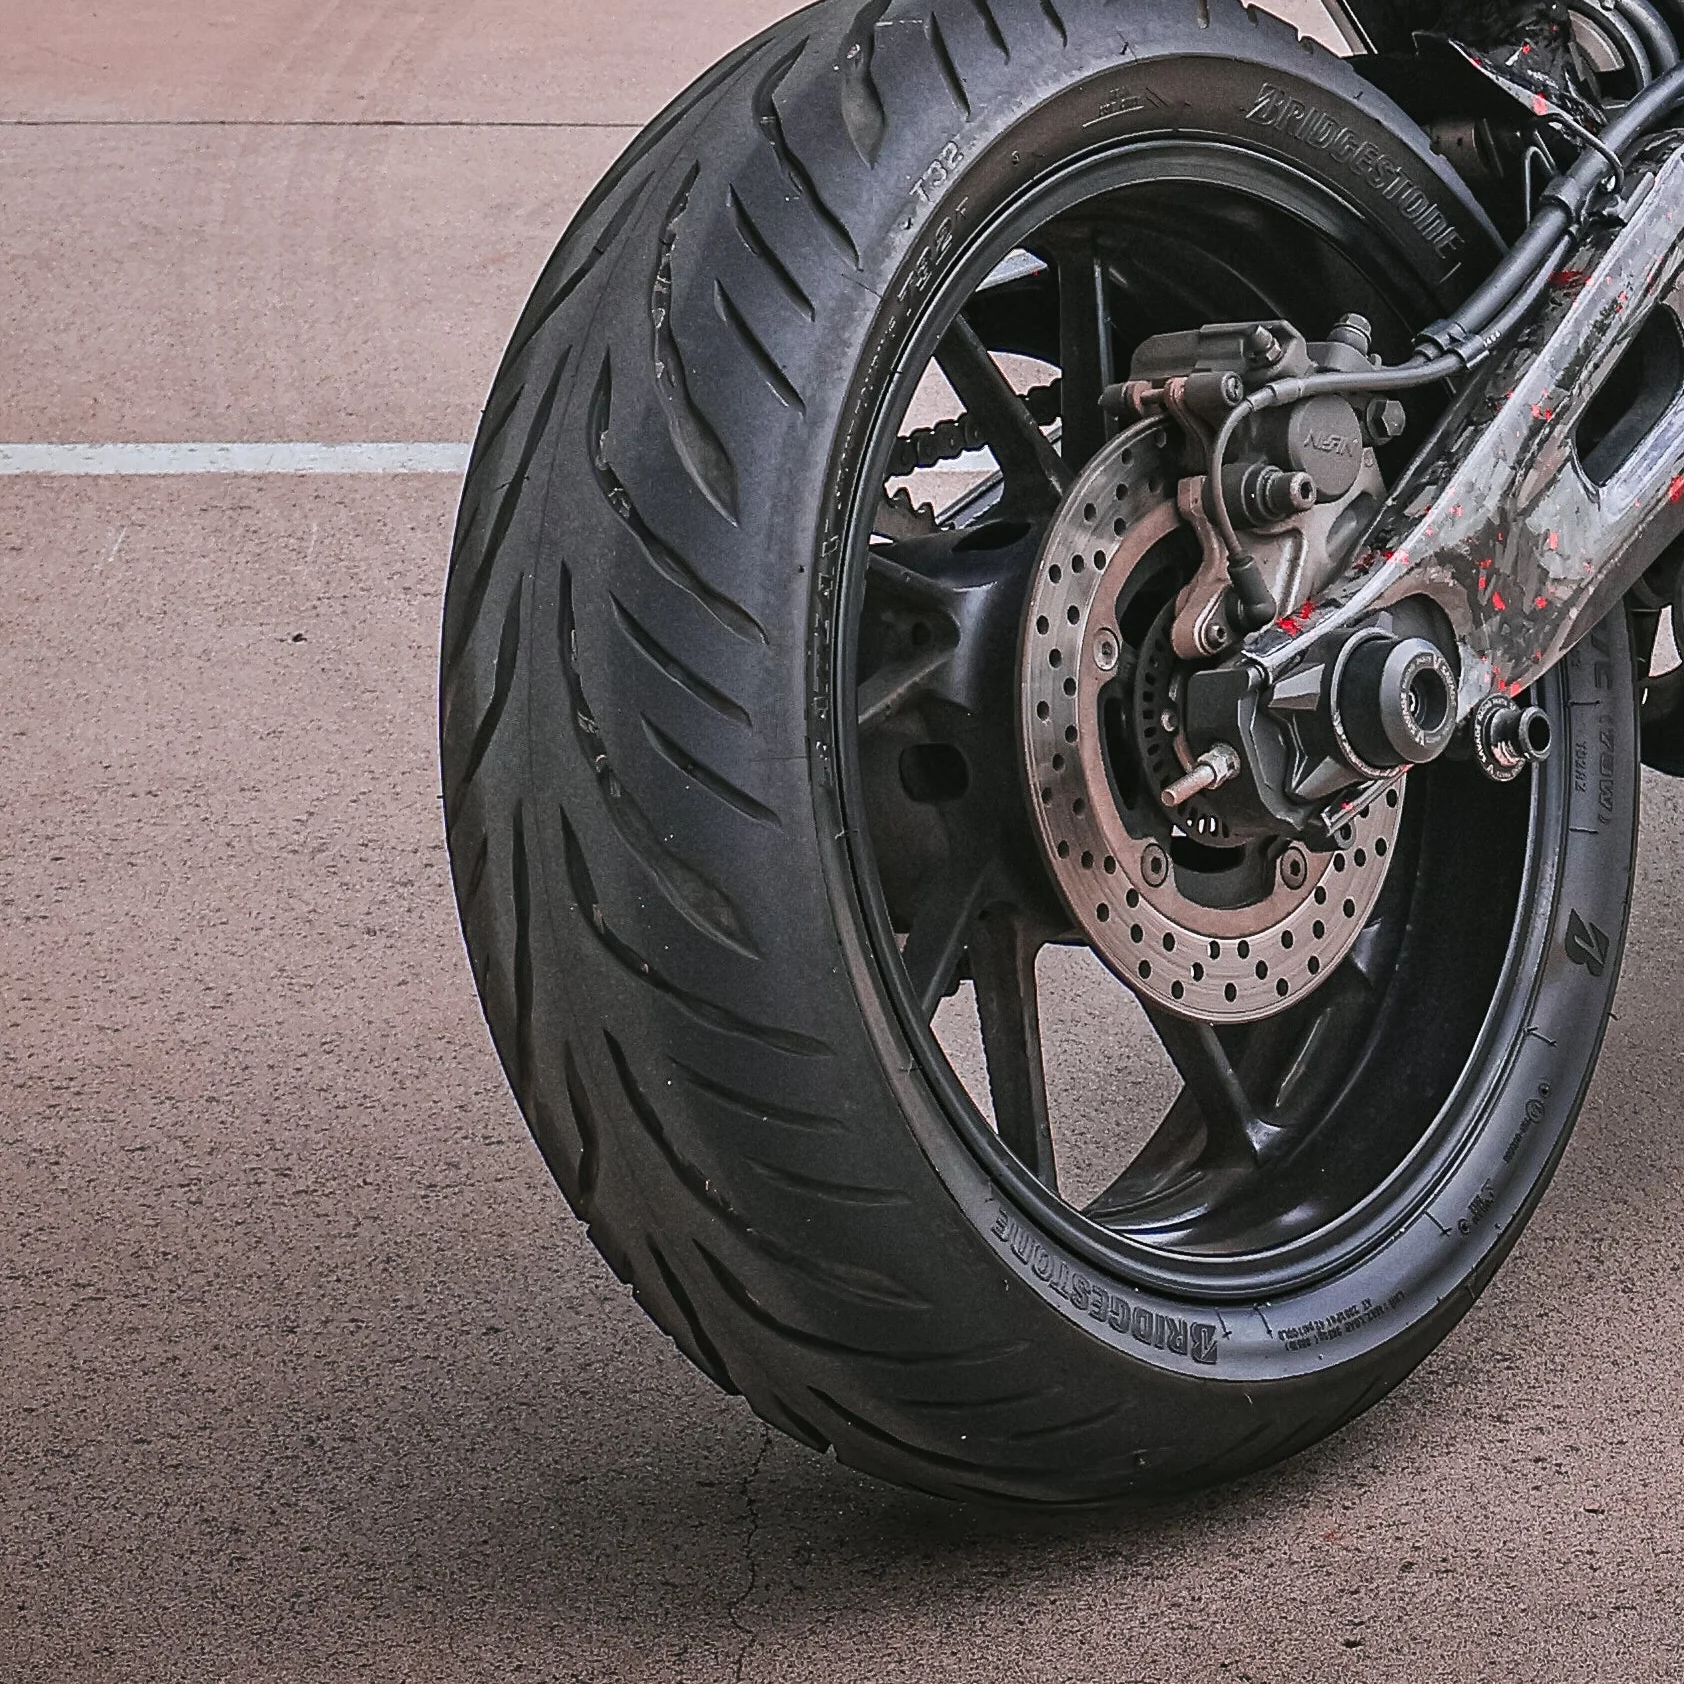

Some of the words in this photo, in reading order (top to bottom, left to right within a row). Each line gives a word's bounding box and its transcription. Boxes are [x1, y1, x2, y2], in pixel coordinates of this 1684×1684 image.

[909, 140, 965, 203] T32
[1245, 82, 1465, 259] BRIDGESTONE
[989, 1207, 1219, 1365] BRIDGESTONE
